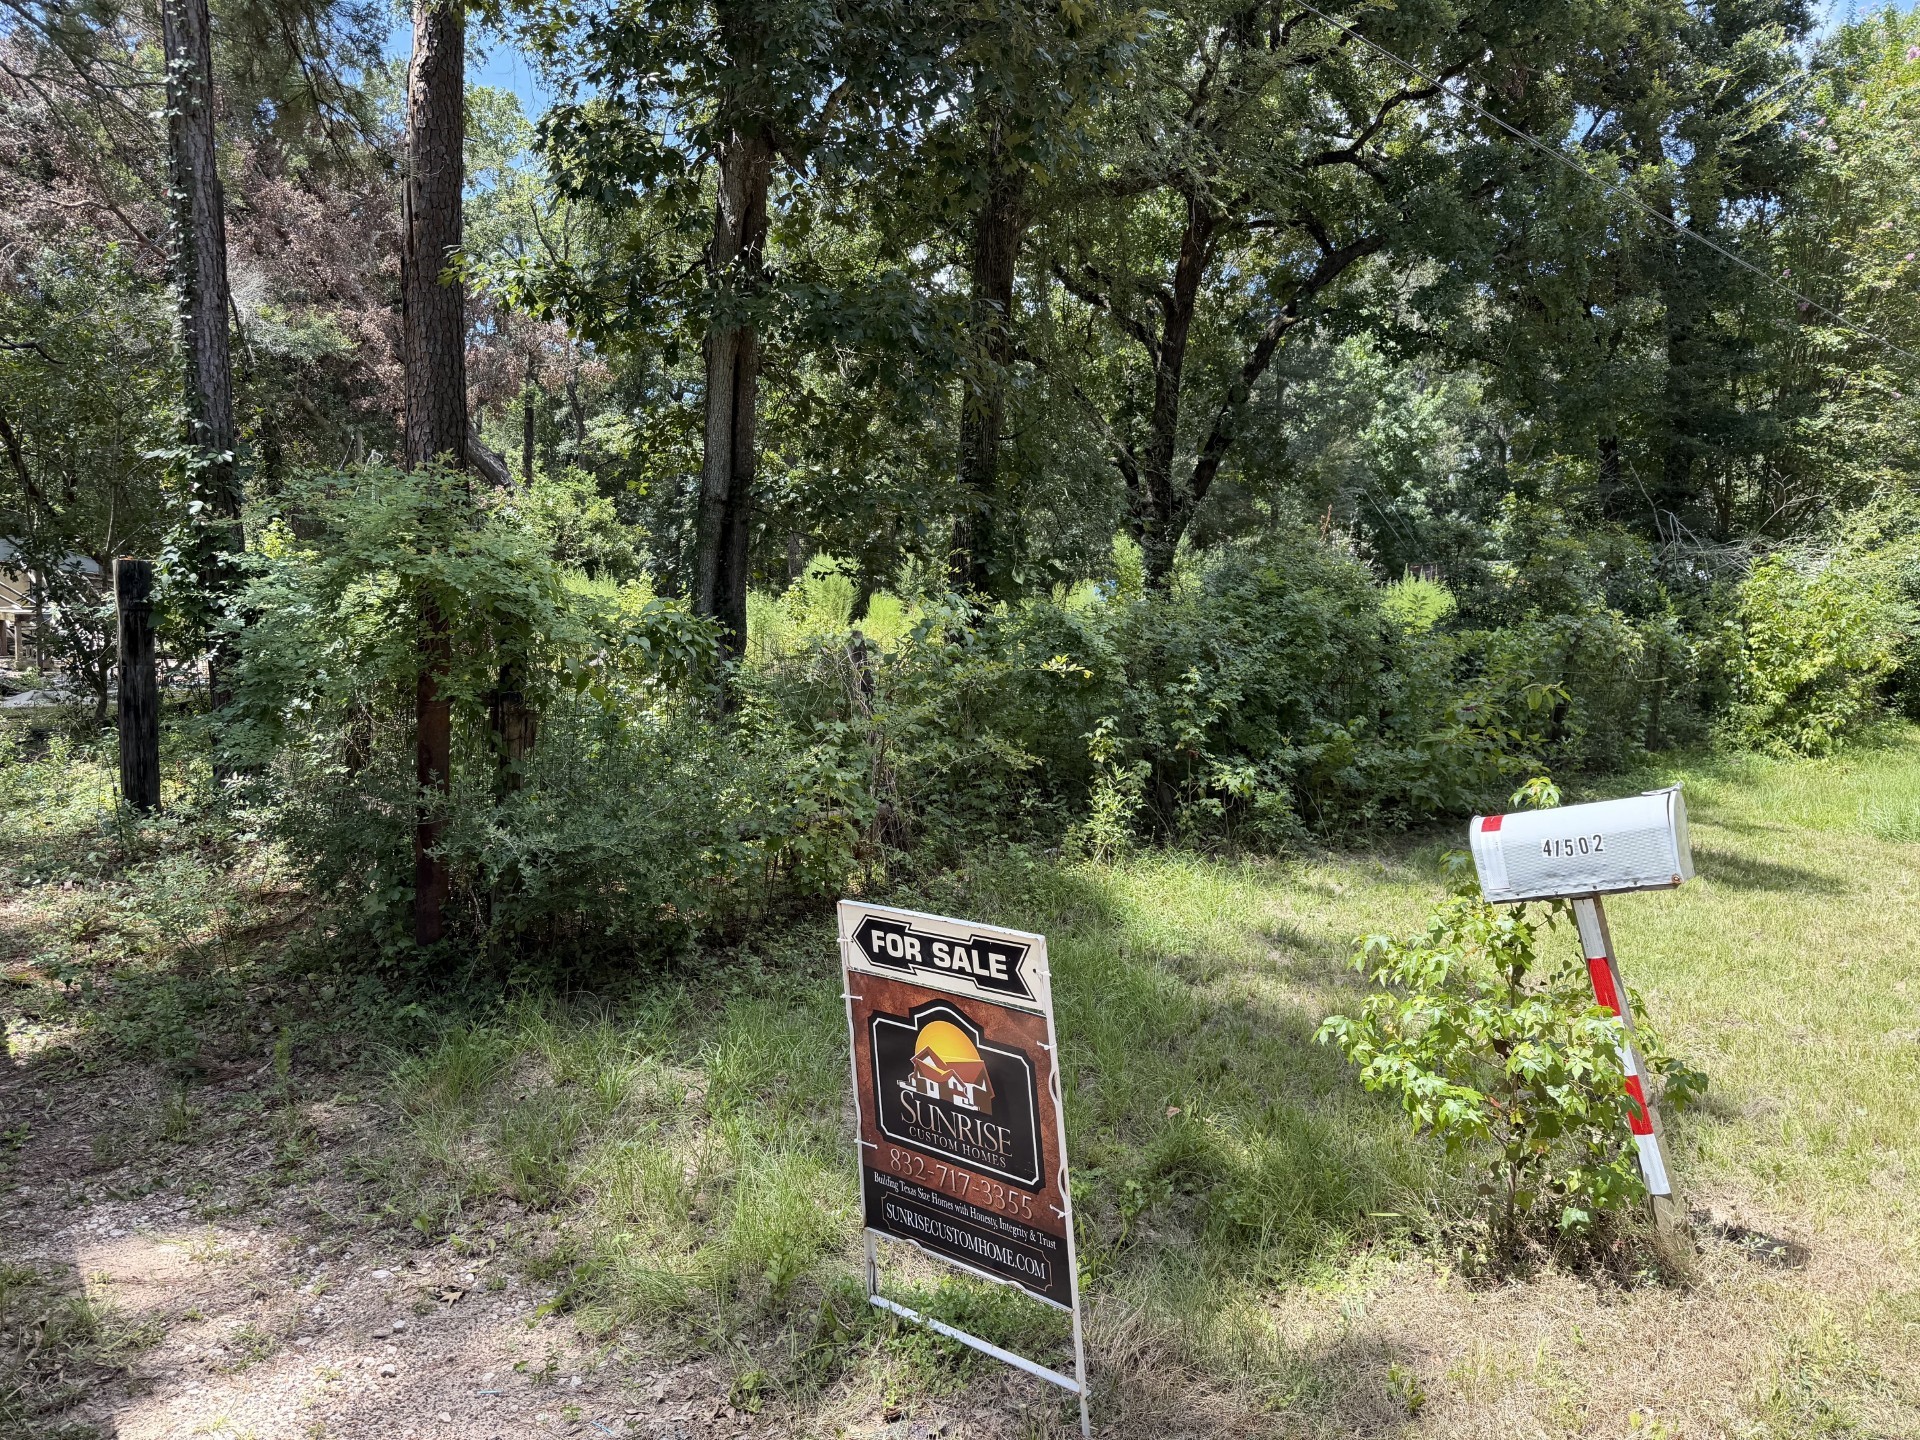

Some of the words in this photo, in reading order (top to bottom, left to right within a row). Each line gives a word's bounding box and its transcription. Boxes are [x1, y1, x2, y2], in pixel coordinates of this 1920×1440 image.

[1543, 834, 1603, 857] 41502
[871, 930, 922, 962] FOR
[932, 941, 1008, 980] SALE
[900, 1090, 1012, 1157] SUNRISE
[909, 1127, 959, 1151] CUSTOM
[963, 1144, 1007, 1168] HOMES
[874, 1172, 899, 1193] Building
[899, 1179, 917, 1197] Texas
[918, 1186, 930, 1202] Size
[932, 1193, 953, 1211] Homes
[955, 1202, 969, 1216] with
[970, 1206, 998, 1229] Honesty,
[999, 1218, 1028, 1240] Integrity
[1030, 1231, 1036, 1241] &
[1037, 1233, 1056, 1250] Trust
[890, 1149, 1032, 1219] 832-717-3355
[886, 1203, 1046, 1279] SUNRISECUSTOMHOME.COM
